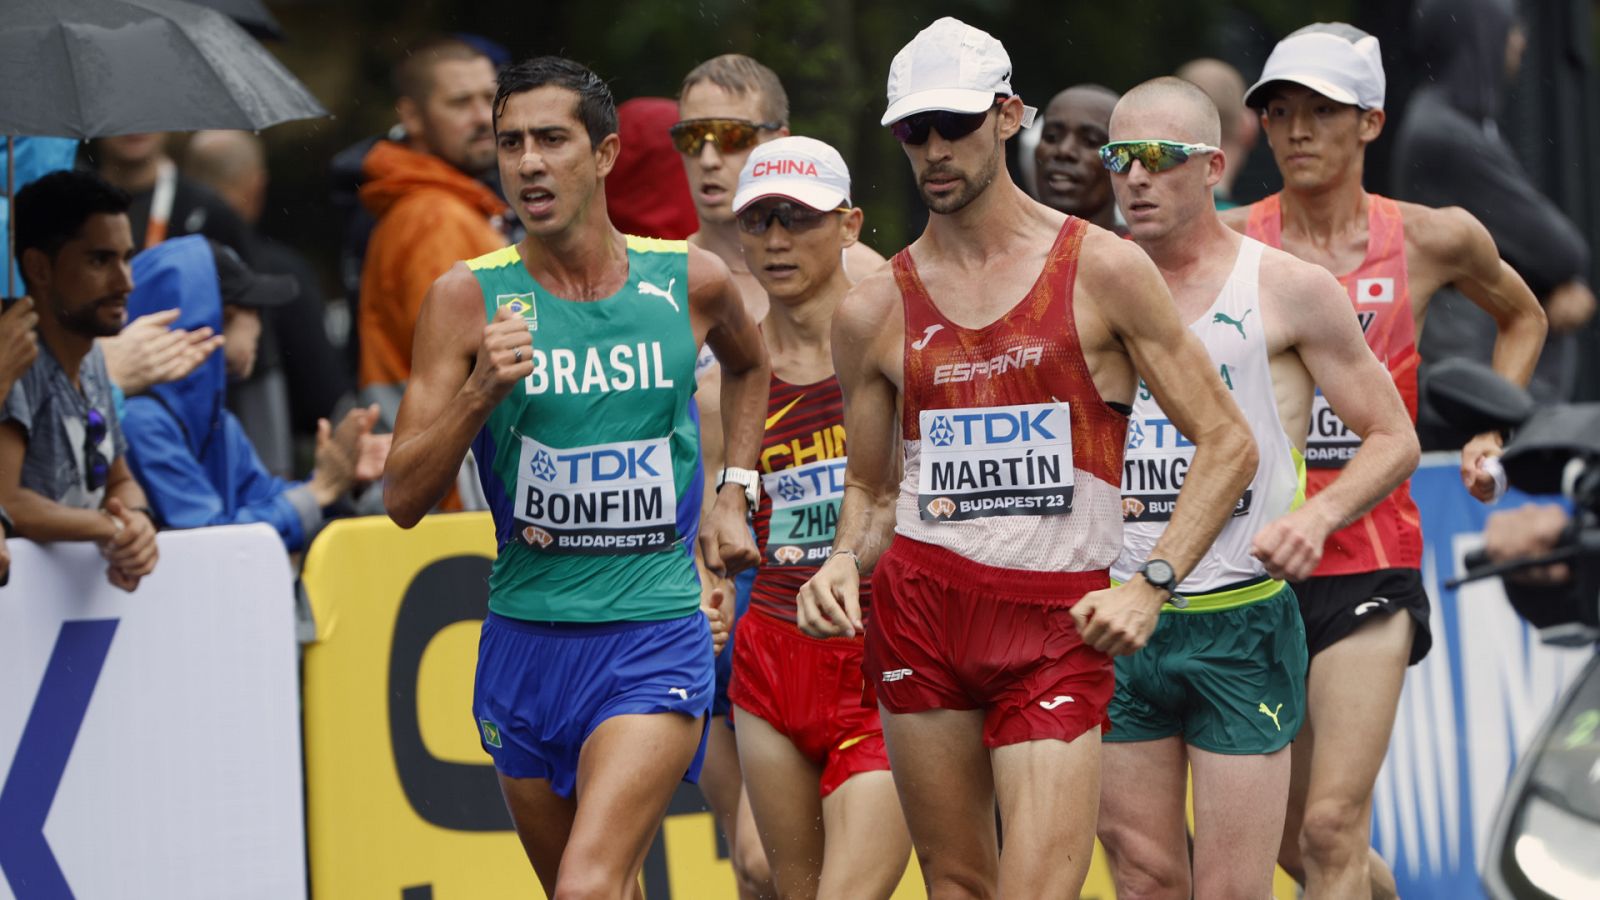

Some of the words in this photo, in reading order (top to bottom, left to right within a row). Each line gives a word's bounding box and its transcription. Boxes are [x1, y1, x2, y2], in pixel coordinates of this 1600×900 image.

[752, 159, 818, 177] CHINA
[525, 341, 674, 396] BRASIL
[933, 345, 1044, 385] ESPAÑA
[953, 408, 1057, 445] TDK
[557, 445, 660, 484] TDK
[931, 449, 1061, 491] MARTÍN
[525, 485, 663, 525] BONFIM
[960, 496, 1043, 513] BUDAPEST
[1046, 494, 1065, 507] 23
[558, 533, 646, 548] BUDAPEST
[648, 532, 665, 545] 23
[882, 668, 913, 682] ESP
